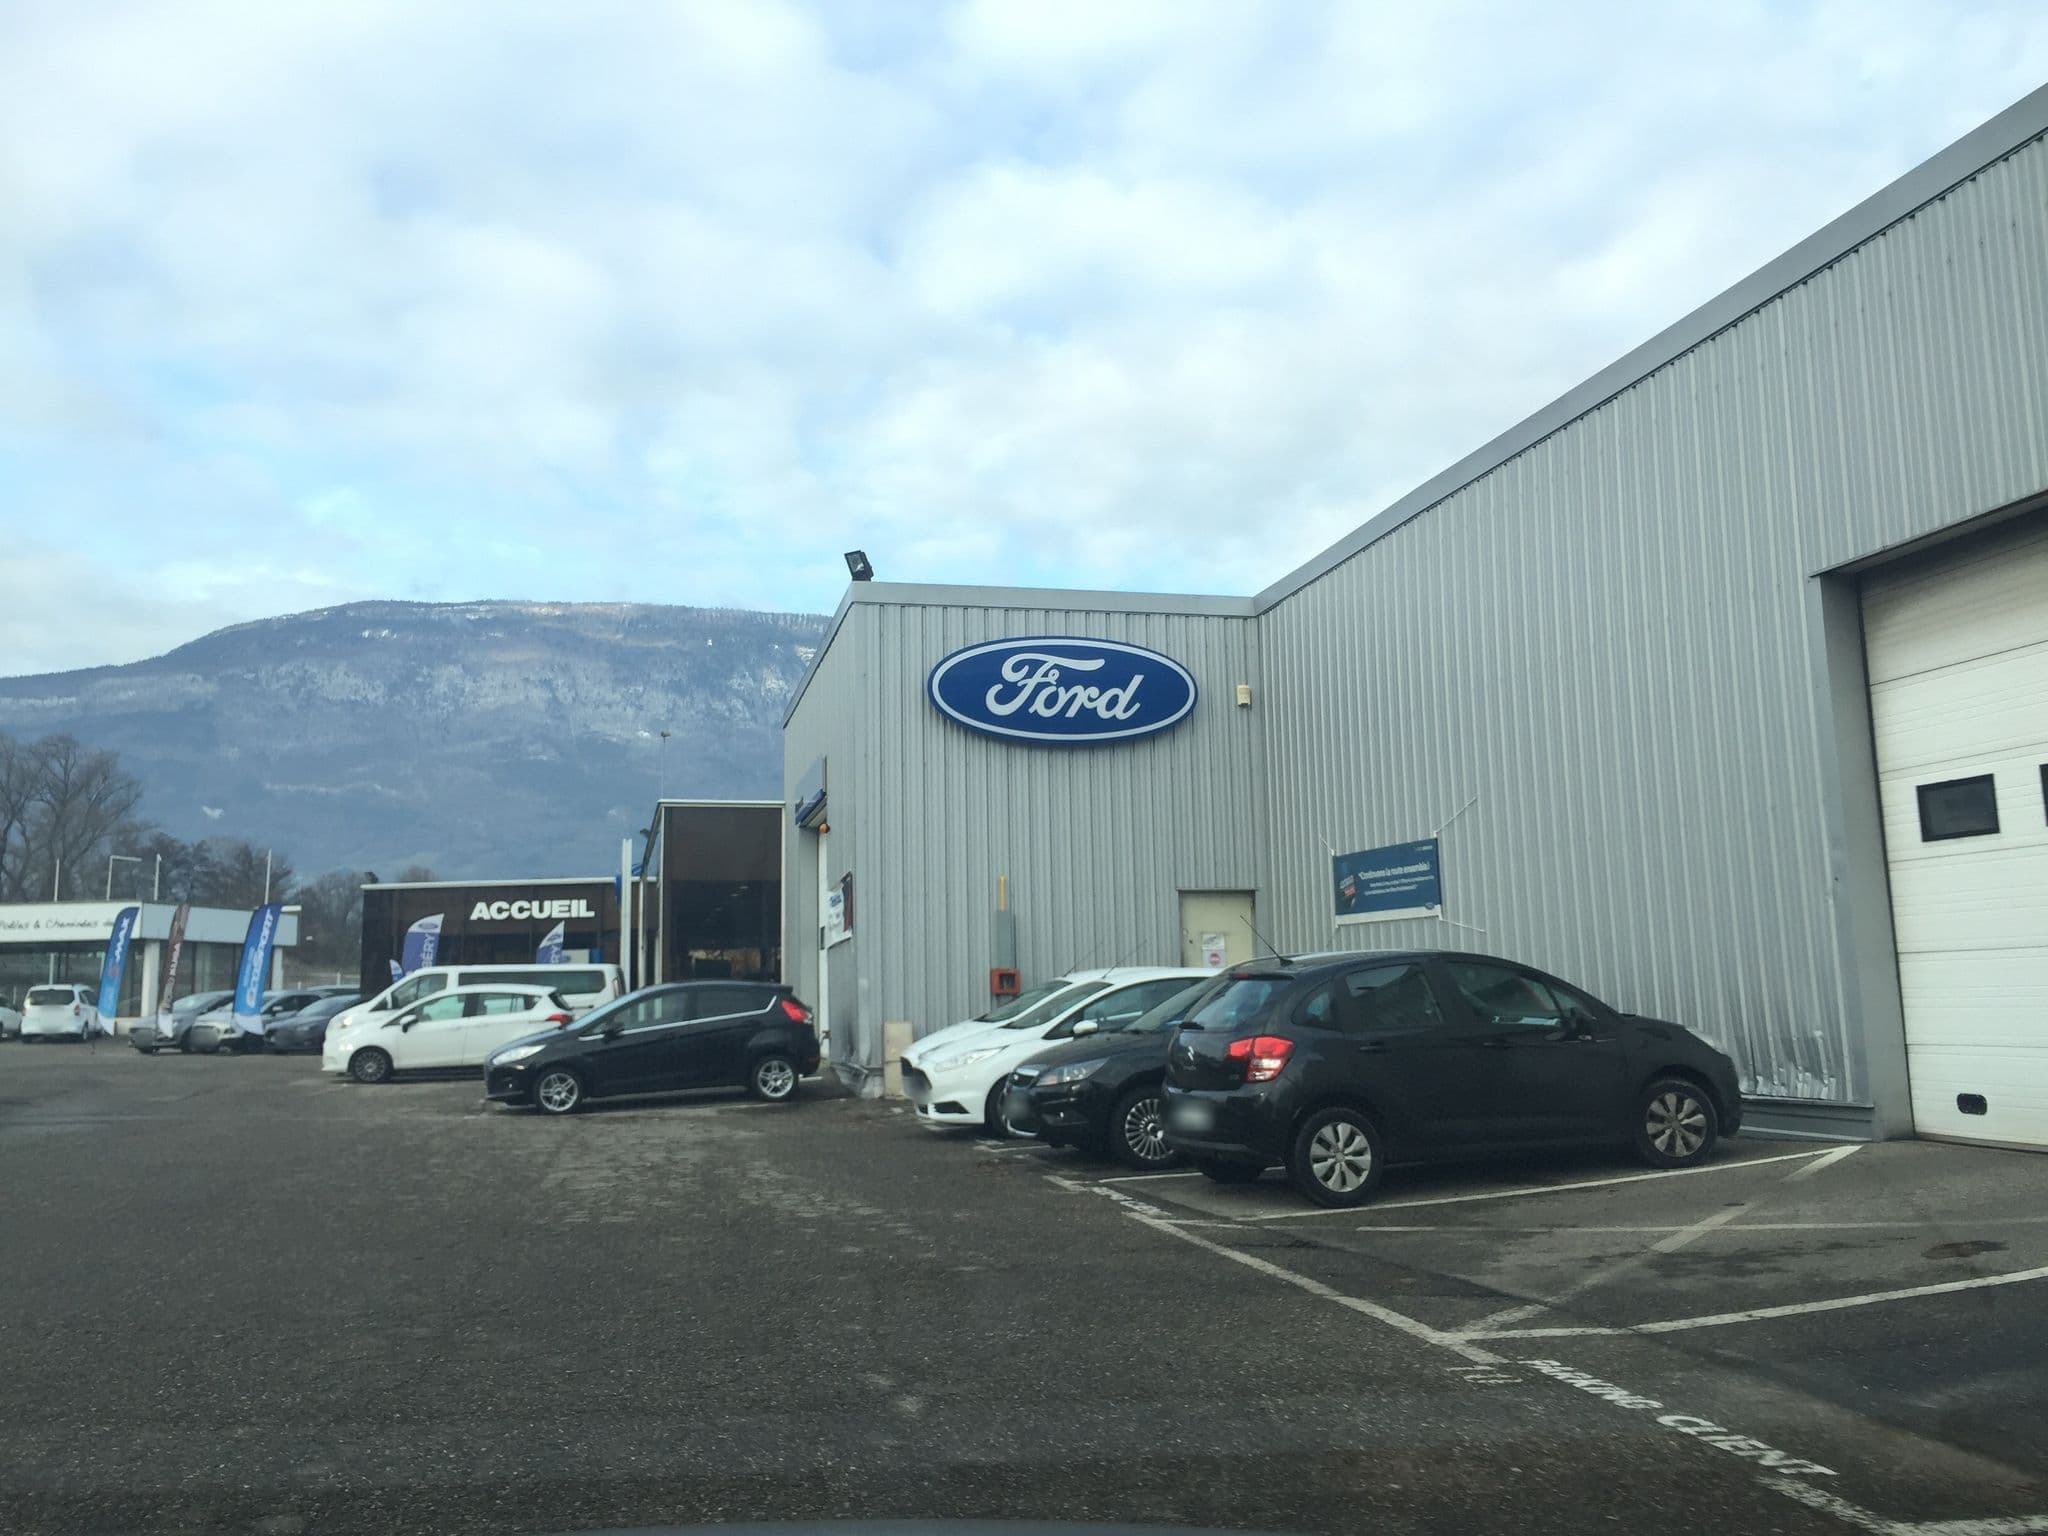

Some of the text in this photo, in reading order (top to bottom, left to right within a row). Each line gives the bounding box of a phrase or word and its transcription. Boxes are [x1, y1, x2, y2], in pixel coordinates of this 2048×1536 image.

[985, 652, 1145, 720] Ford
[470, 899, 595, 920] ACCUEIL
[1519, 1359, 1839, 1475] PARKING CLIENT
